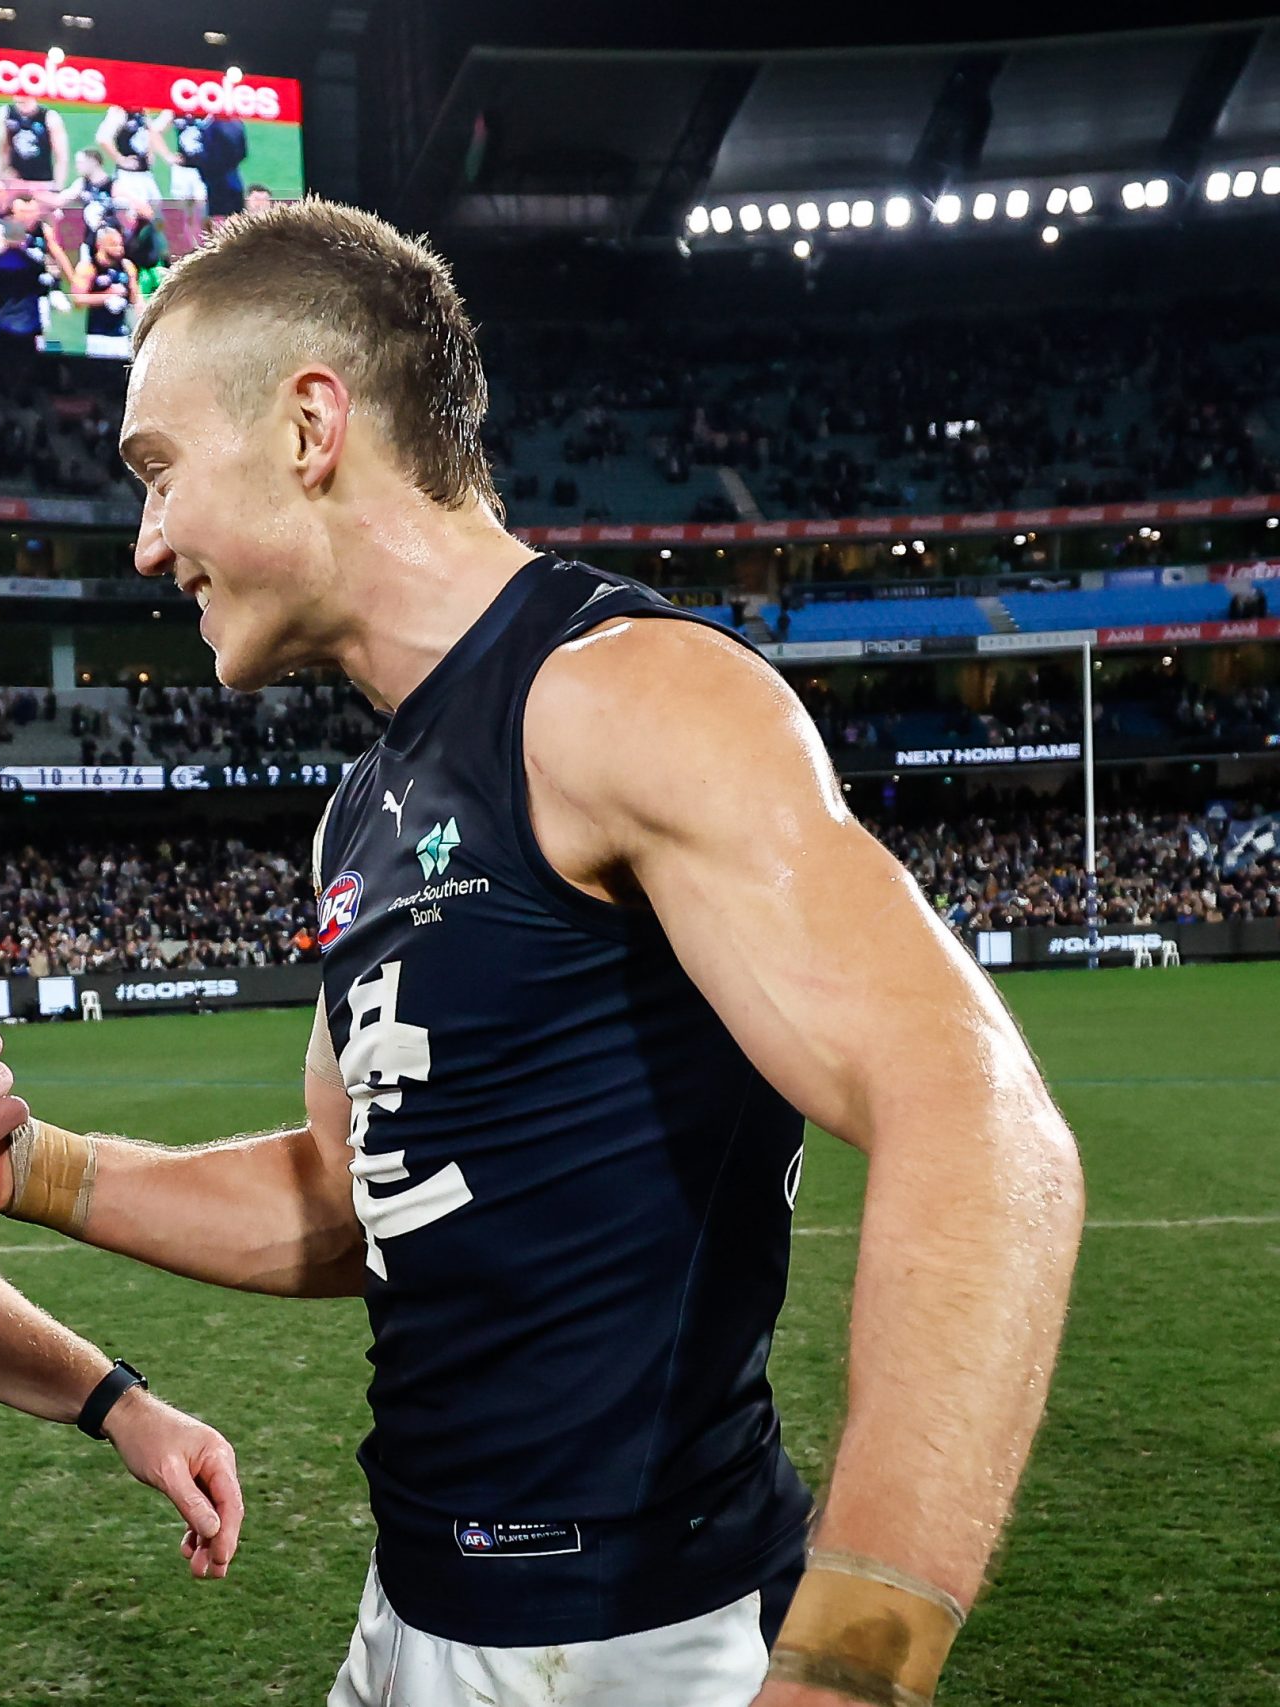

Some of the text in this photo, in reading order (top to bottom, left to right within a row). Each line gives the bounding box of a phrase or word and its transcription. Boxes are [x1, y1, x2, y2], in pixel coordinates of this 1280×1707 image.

[170, 74, 280, 119] coles
[895, 743, 1081, 766] NEXT HOME GAME
[418, 876, 490, 903] Southern
[319, 888, 354, 933] AFL
[410, 902, 443, 927] Bank
[464, 1534, 492, 1548] AFL
[498, 1533, 530, 1544] PLAYER
